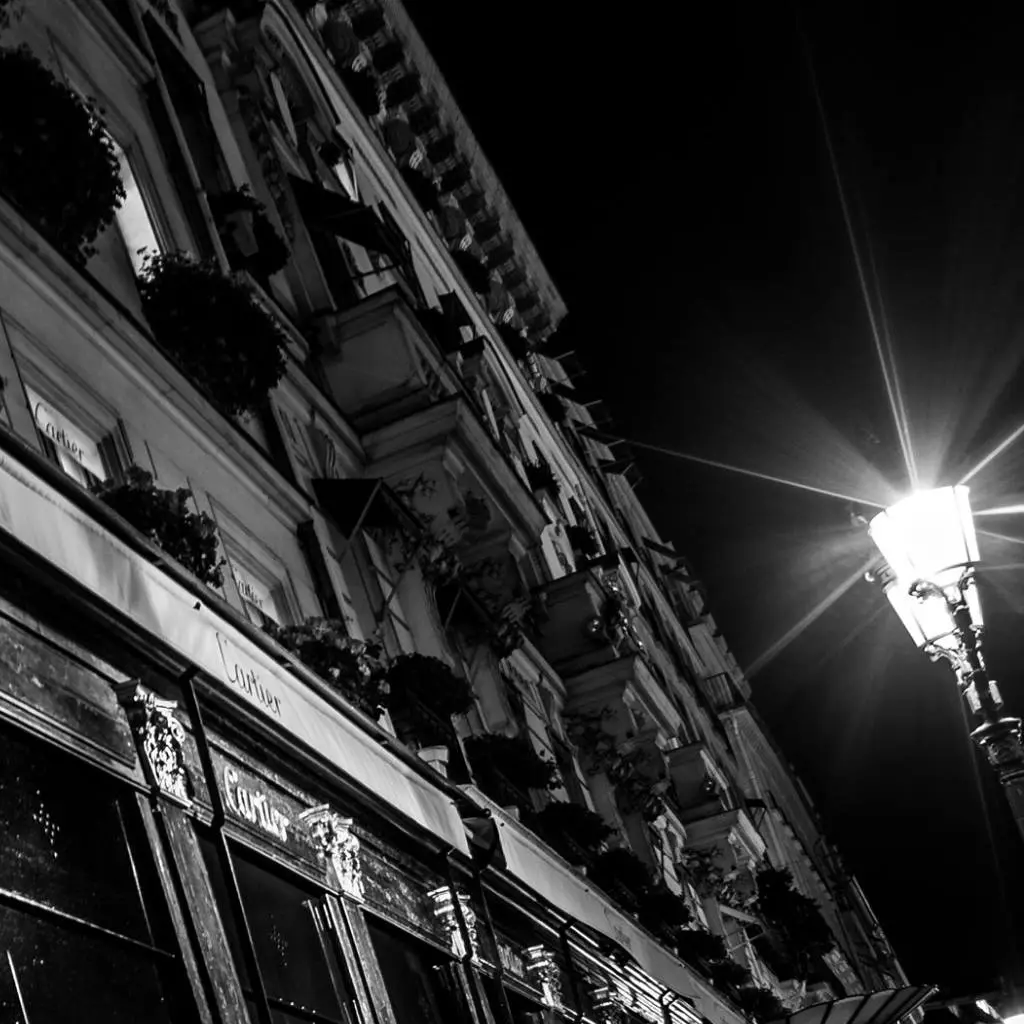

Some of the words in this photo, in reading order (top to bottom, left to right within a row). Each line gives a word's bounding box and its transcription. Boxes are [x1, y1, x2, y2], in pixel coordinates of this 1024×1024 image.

[34, 402, 85, 461] Cartier
[215, 631, 282, 718] Cartier
[223, 766, 291, 843] Cartier
